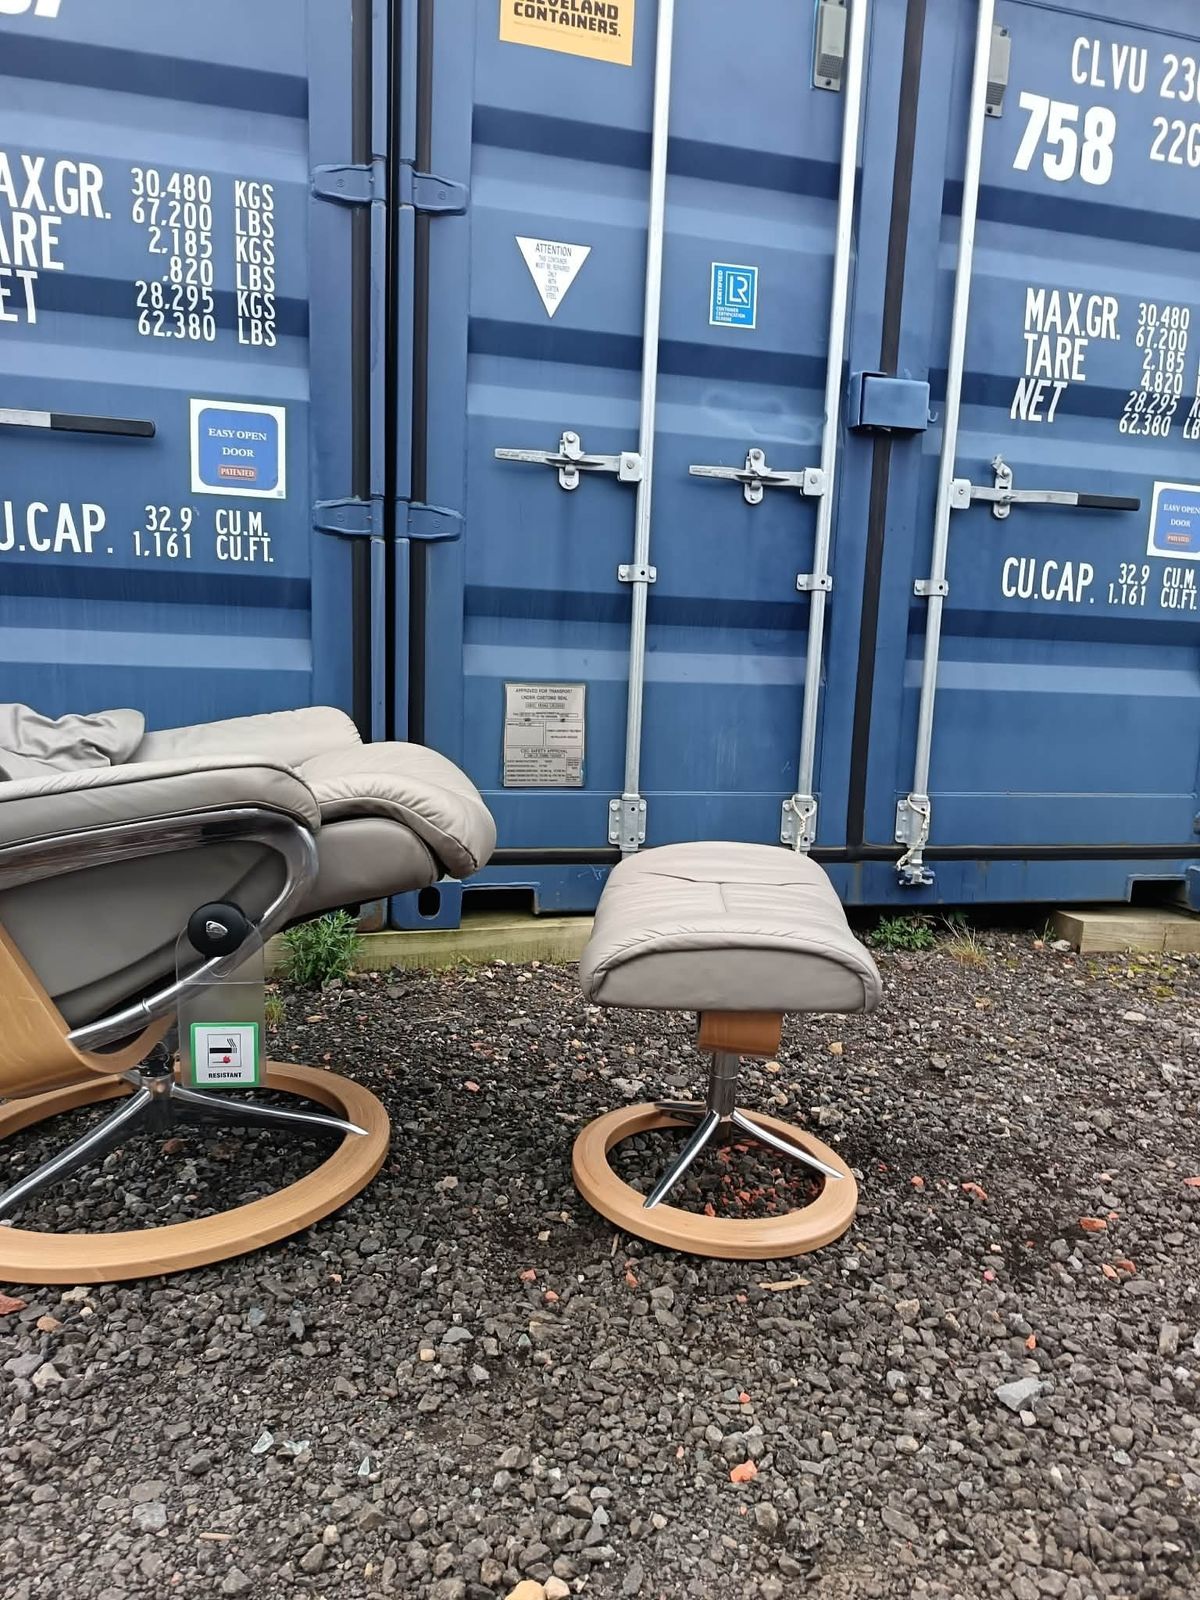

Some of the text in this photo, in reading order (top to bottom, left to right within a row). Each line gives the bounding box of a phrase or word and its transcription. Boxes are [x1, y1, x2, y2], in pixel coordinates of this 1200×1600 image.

[514, 2, 621, 37] CONTAINERS.
[1071, 37, 1200, 104] CLVU 23
[1012, 91, 1117, 186] 758
[235, 180, 274, 211] KGS
[236, 207, 275, 239] LBS
[236, 236, 275, 266] KGS
[536, 243, 572, 256] ATTENTION
[236, 263, 275, 293] LBS
[236, 290, 276, 320] KGS
[1024, 287, 1120, 340] MAX.GR.
[238, 317, 277, 347] LBS
[1024, 333, 1088, 381] TARE
[1010, 377, 1068, 422] NET
[208, 428, 267, 441] EASY OPEN
[222, 447, 255, 457] DOOR
[145, 505, 268, 536] 32.9 CU.M.
[1164, 503, 1180, 512] EASY
[216, 535, 274, 562] CU.FT.
[1002, 557, 1094, 603] CU.CAP.
[1119, 563, 1196, 589] 32.9 CU.M.
[1161, 587, 1197, 610] CU.FT.
